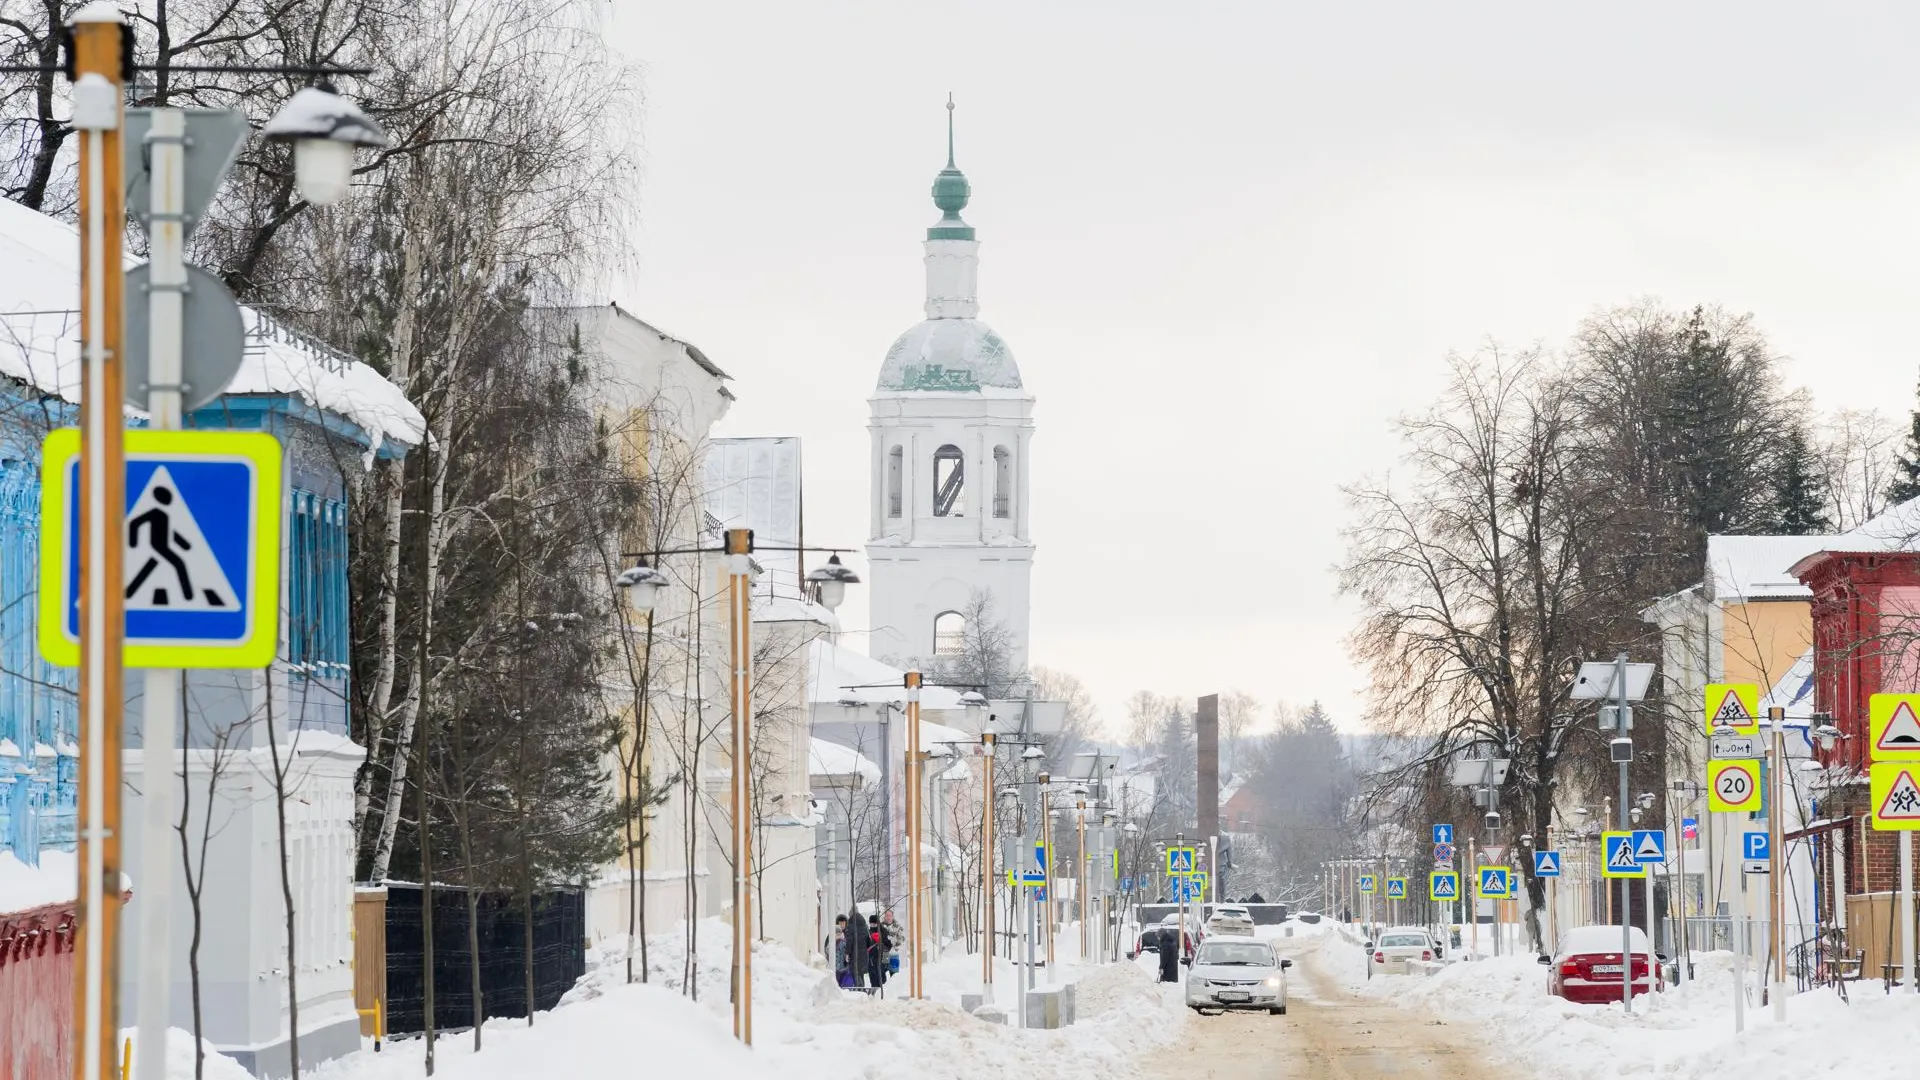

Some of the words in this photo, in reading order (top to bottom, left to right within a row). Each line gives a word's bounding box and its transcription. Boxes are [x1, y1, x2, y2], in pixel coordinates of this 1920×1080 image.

[1722, 744, 1744, 753] 0м
[1723, 778, 1745, 793] 20
[1750, 834, 1767, 857] P
